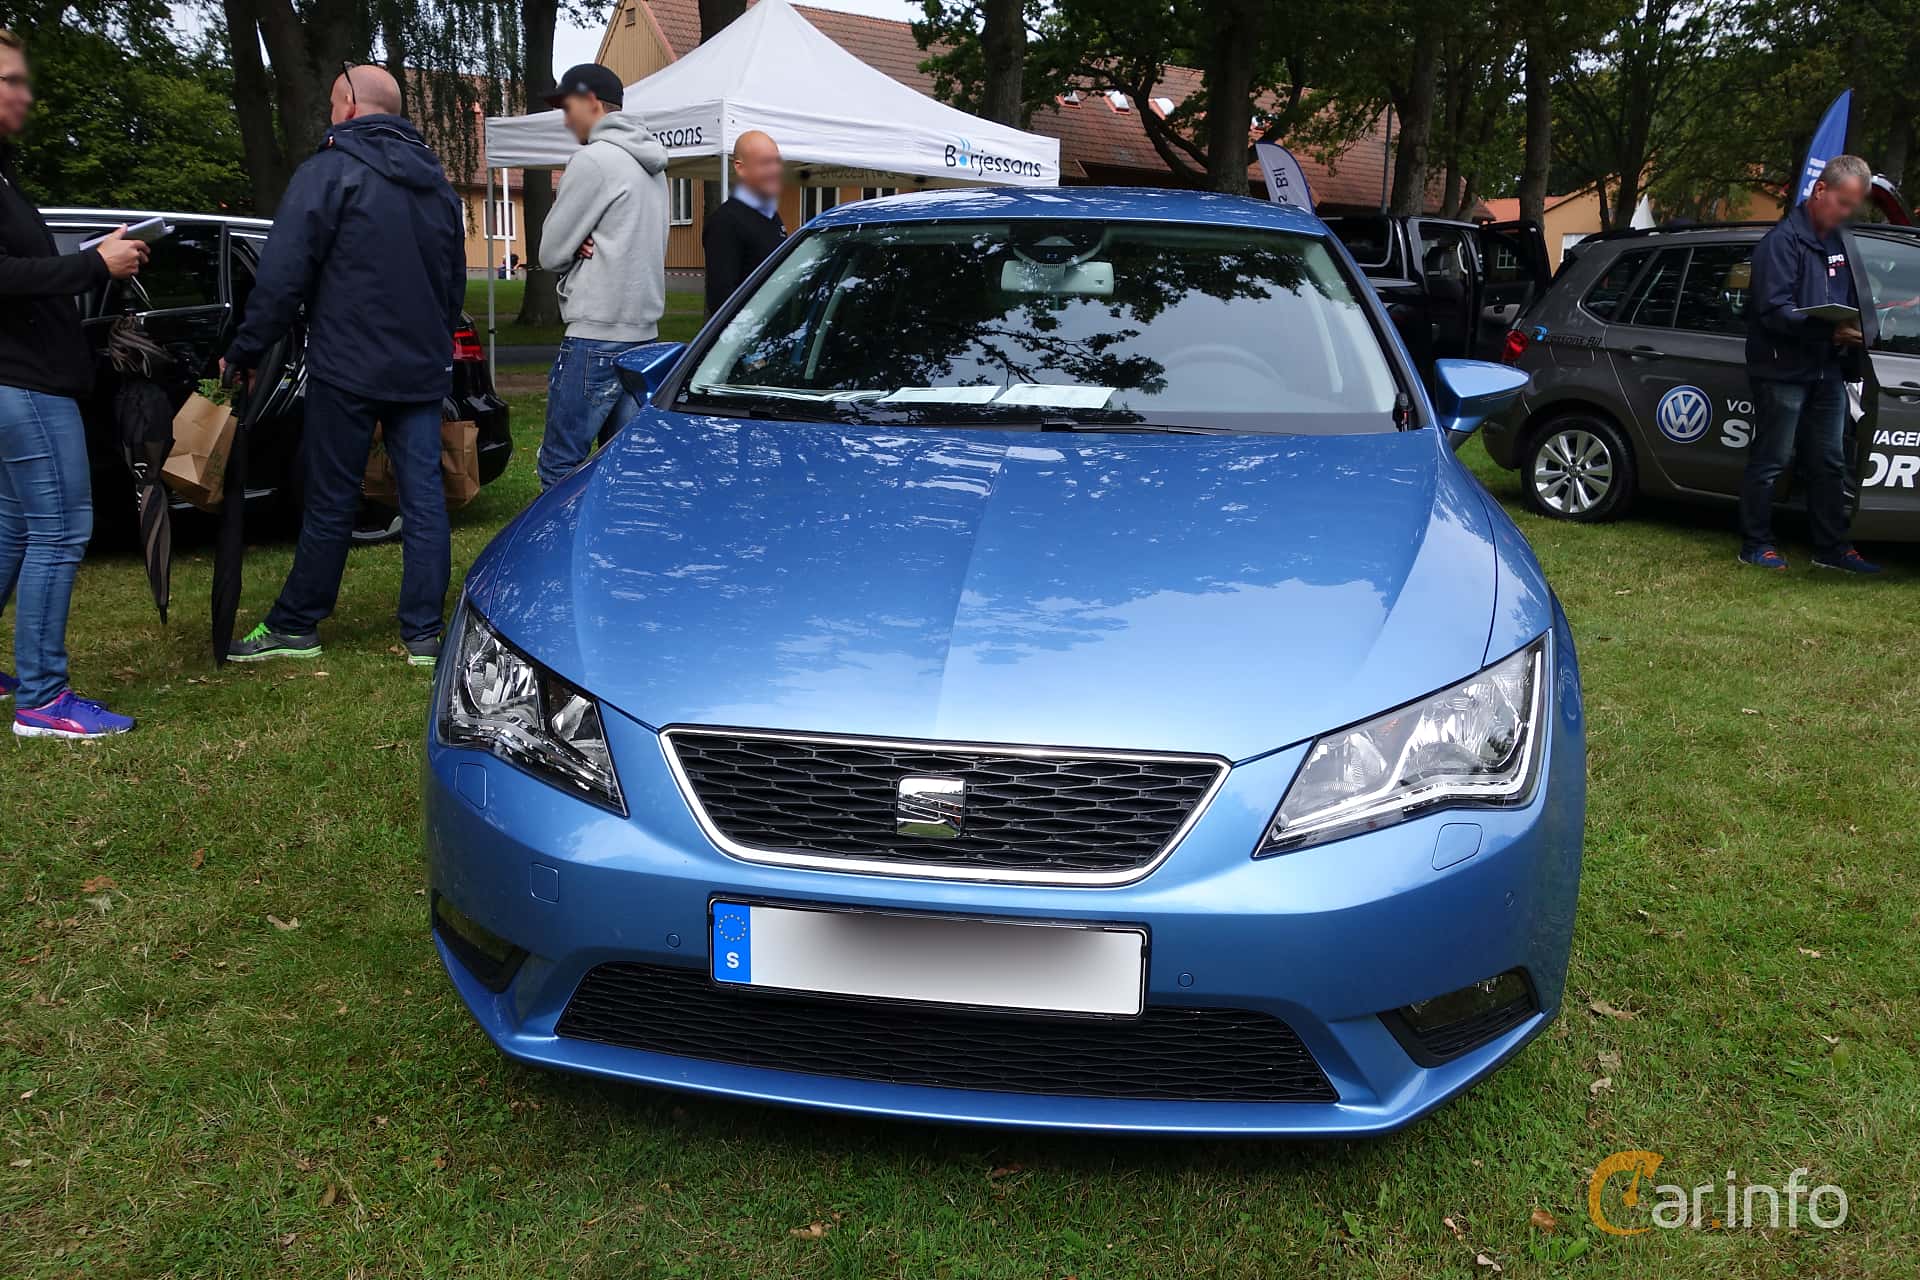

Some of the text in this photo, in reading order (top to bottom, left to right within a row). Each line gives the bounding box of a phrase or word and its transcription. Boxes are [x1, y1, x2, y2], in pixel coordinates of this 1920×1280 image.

[651, 126, 703, 148] ssons
[1726, 399, 1755, 414] VO
[1720, 419, 1756, 448] S
[1872, 430, 1920, 447] AGE
[726, 951, 740, 969] S
